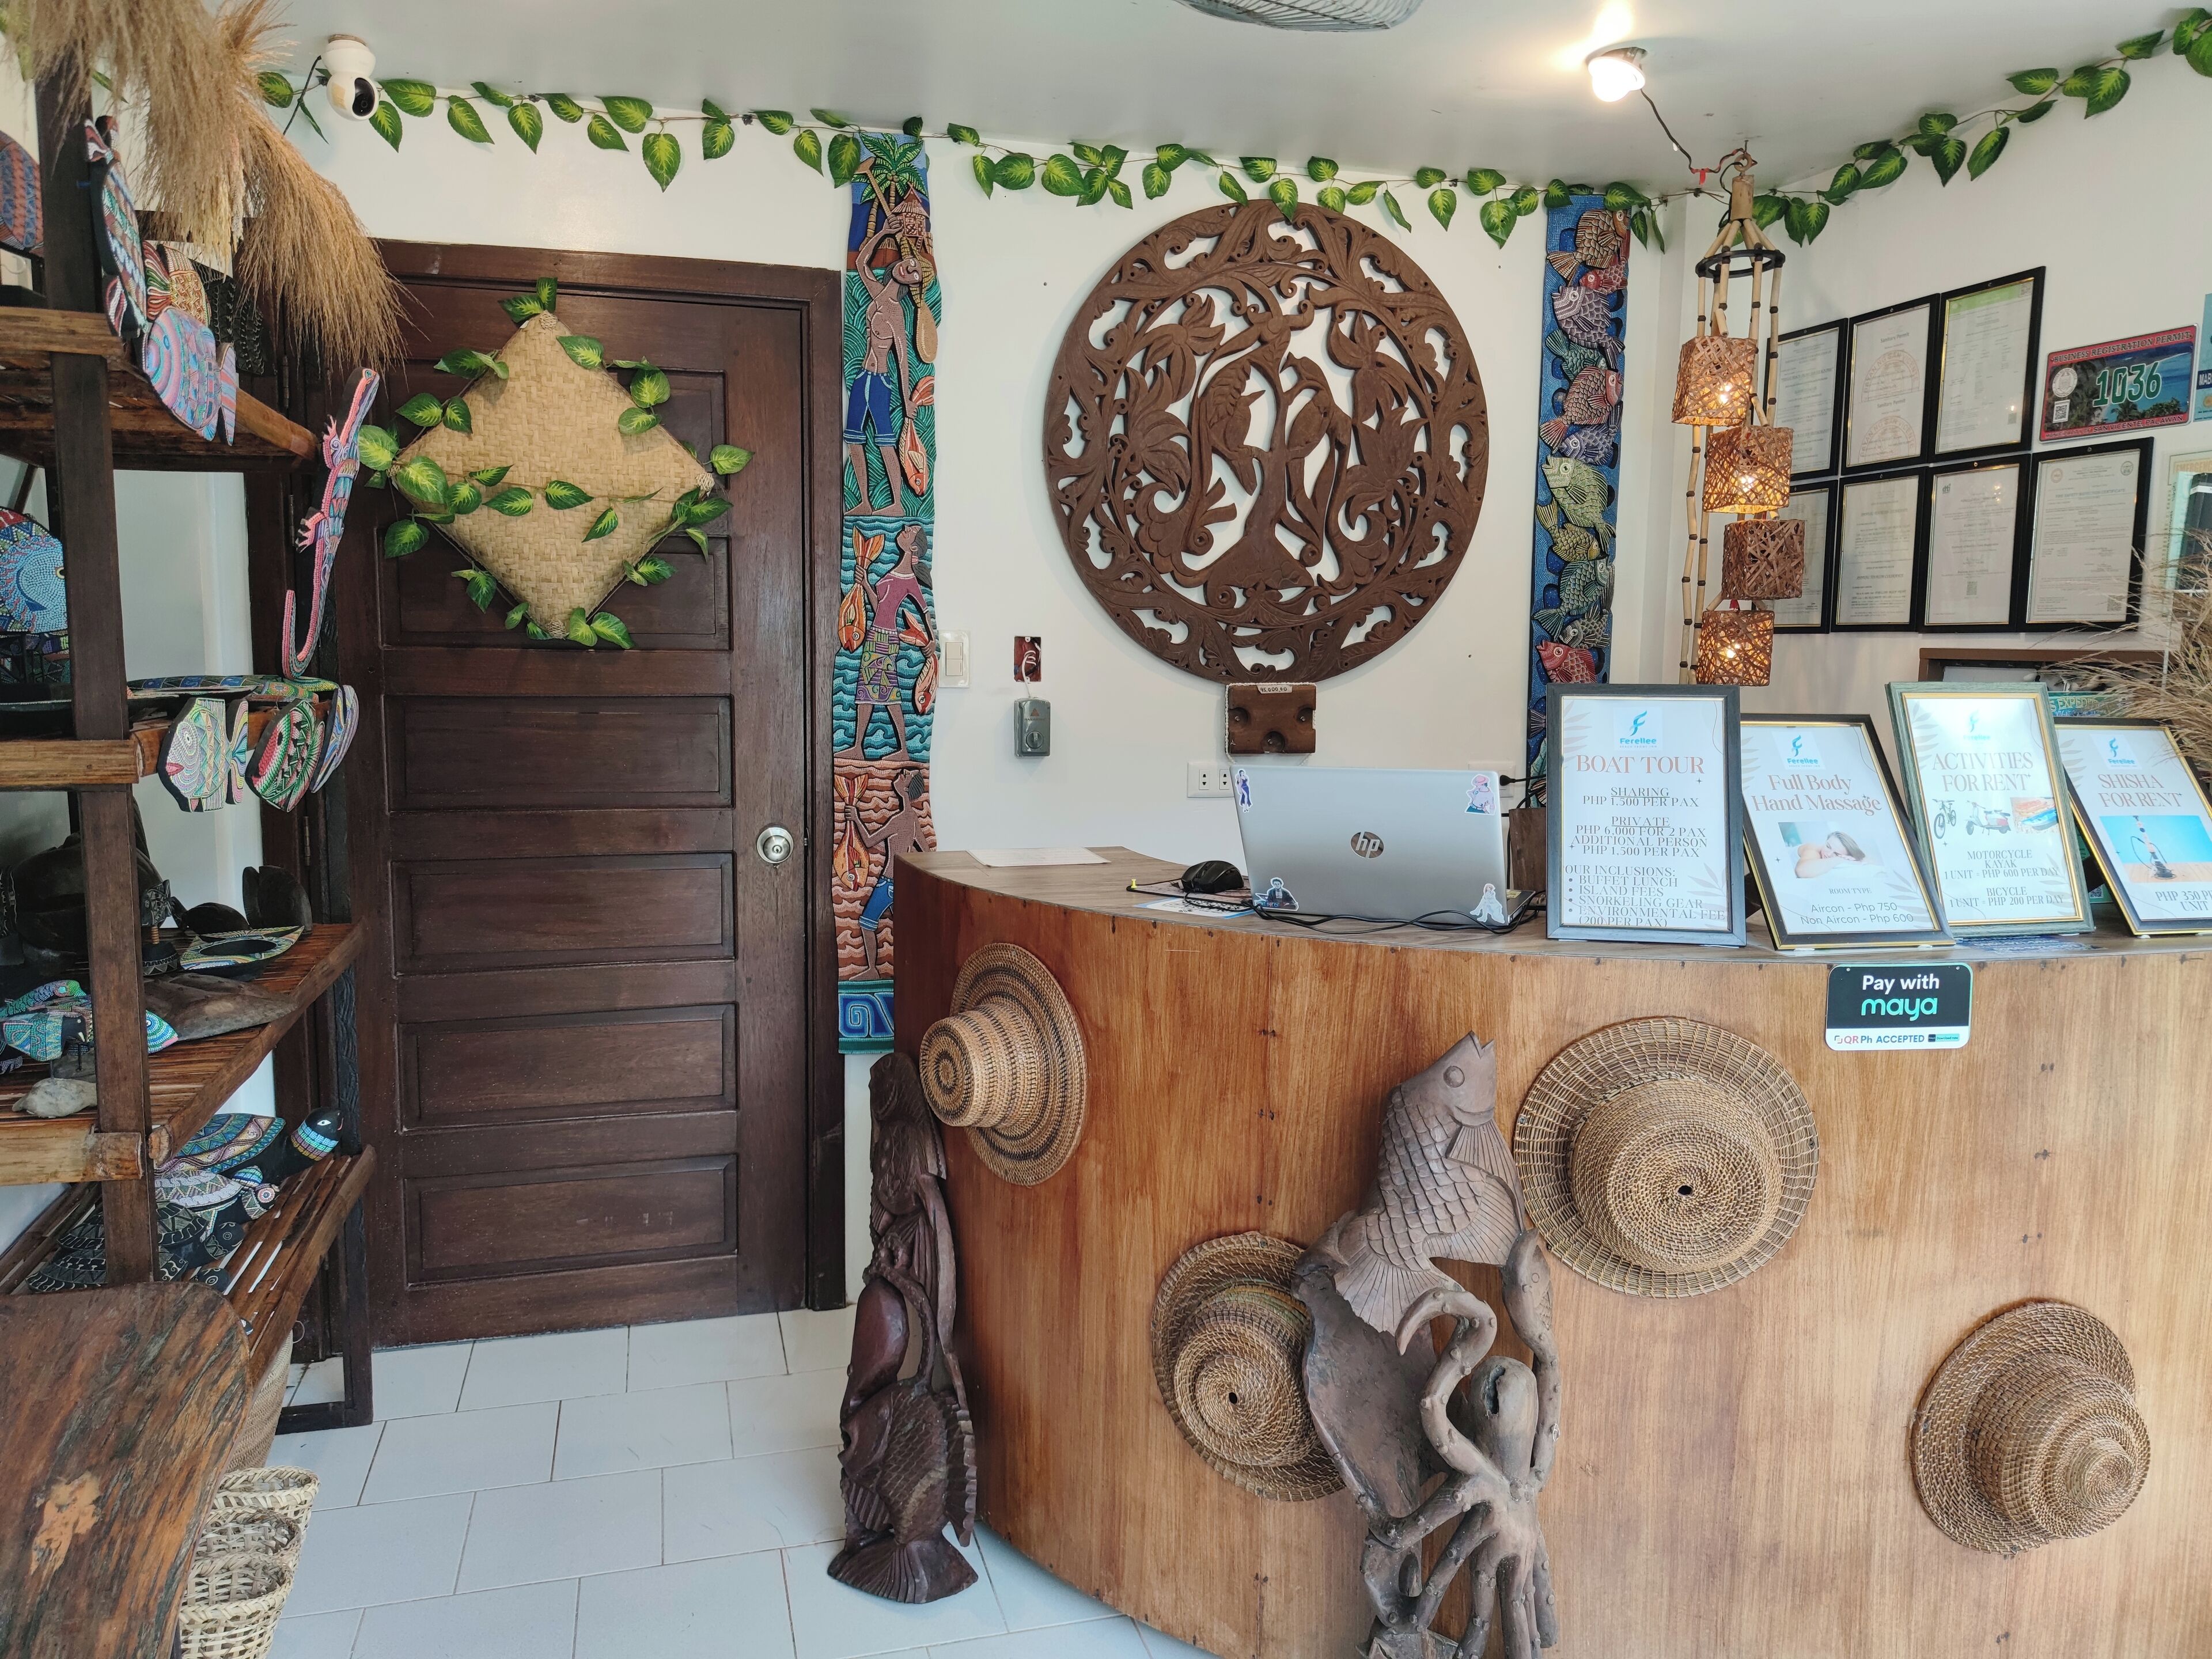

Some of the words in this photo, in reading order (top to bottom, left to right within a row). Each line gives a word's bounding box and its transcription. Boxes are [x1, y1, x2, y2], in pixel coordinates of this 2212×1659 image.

[2054, 350, 2089, 363] BUSINESS
[2091, 338, 2153, 357] REGISTRATION
[2156, 331, 2190, 346] PERMIT
[2092, 361, 2162, 408] 1036
[2199, 373, 2212, 386] MAB
[2146, 415, 2183, 425] PALAWAN
[1576, 755, 1635, 774] BOAT
[1640, 756, 1705, 774] TOUR
[1933, 752, 2033, 770] ACTIVITIES
[1767, 774, 1805, 791] Full
[1805, 774, 1851, 795] Body
[1942, 774, 1980, 792] FOR
[1981, 774, 2028, 791] RENT
[2098, 774, 2165, 789] SHISHA
[1611, 787, 1669, 797] SHARING
[1583, 796, 1607, 805] PHP
[1643, 798, 1668, 806] PER
[1672, 798, 1699, 806] PAX
[1751, 794, 1804, 812] Hand
[1804, 794, 1883, 816] Massage
[2098, 792, 2138, 807] FOR
[2134, 792, 2182, 807] RENT
[1611, 816, 1671, 826] PRIVATE
[1576, 825, 1600, 834] PHP
[1639, 827, 1664, 836] FOR
[1668, 828, 1675, 836] 2
[1679, 828, 1706, 837] PAX
[1355, 831, 1380, 859] hp
[1571, 835, 1654, 846] ADDITIONAL
[1658, 837, 1707, 848] PERSON
[1583, 845, 1607, 854] PHP
[1644, 847, 1668, 857] PER
[1672, 848, 1699, 857] PAX
[1967, 850, 2033, 860] MOTORCYCLE
[1984, 859, 2017, 869] KAYAK
[1565, 865, 1590, 874] OUR
[1595, 865, 1676, 877] INCLUSIONS:
[1944, 872, 1948, 880] 1
[1950, 870, 1973, 880] UNIT
[1982, 869, 2001, 878] PHP
[2003, 869, 2019, 877] 600
[2020, 868, 2039, 877] PER
[2040, 867, 2060, 876] DAY
[1579, 876, 1630, 886] BUFFET
[1634, 877, 1678, 887] LUNCH
[1579, 885, 1627, 896] ISLAND
[1632, 887, 1664, 897] FEES
[1986, 887, 2028, 897] BICYCLE
[2155, 891, 2178, 902] PHP
[2181, 891, 2200, 900] 350
[1579, 896, 1662, 908] SNORKELING
[1666, 899, 1703, 909] GEAR
[1949, 899, 1954, 907] 1
[1955, 897, 1979, 907] UNIT
[1988, 897, 2006, 906] PHP
[2009, 896, 2025, 905] 200
[2027, 895, 2045, 905] PER
[2046, 895, 2065, 904] DAY
[2180, 901, 2209, 911] UNIT
[1579, 906, 1696, 919] ENVIRONMENTAL
[1700, 910, 1725, 920] FEE
[1811, 904, 1845, 913] Aircon
[1854, 903, 1876, 912] Php
[1877, 902, 1897, 911] 750
[1579, 916, 1604, 925] (200
[1608, 916, 1632, 926] PER
[1636, 918, 1668, 927] PAX)
[1800, 916, 1823, 925] Non
[1826, 915, 1860, 924] Aircon
[1870, 914, 1891, 924] Php
[1893, 914, 1914, 922] 600
[1862, 975, 1895, 995] Pay
[1900, 974, 1940, 990] with
[1861, 997, 1938, 1021] maya
[1876, 1035, 1925, 1044] ACCEPTED
